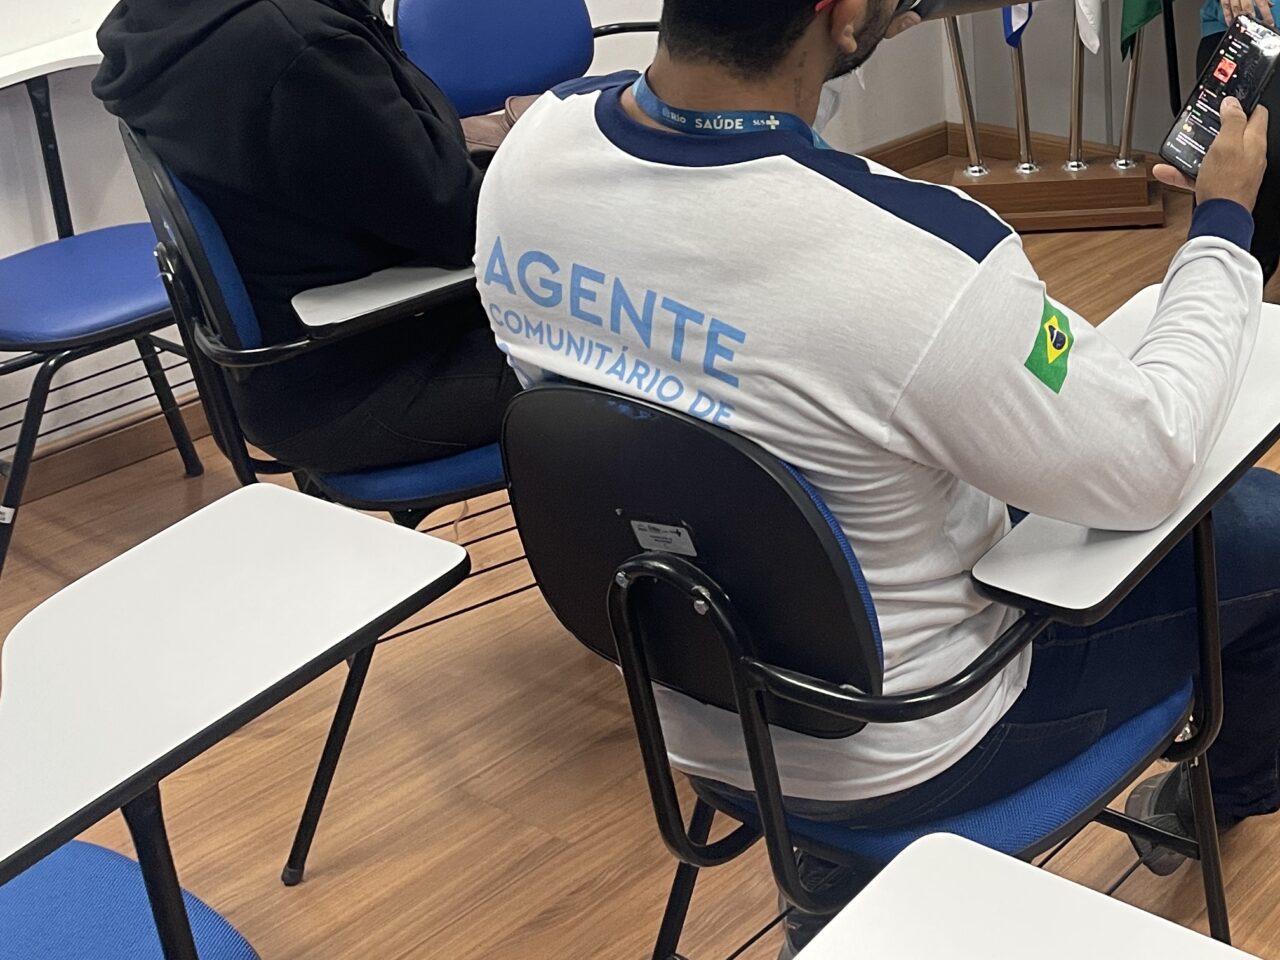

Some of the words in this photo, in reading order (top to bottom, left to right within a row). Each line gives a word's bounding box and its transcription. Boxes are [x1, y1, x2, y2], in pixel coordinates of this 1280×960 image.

[695, 115, 744, 130] SAÚDE
[483, 235, 746, 389] AGENTE
[489, 303, 684, 402] COMUNITÁRIO
[688, 389, 736, 429] DE
